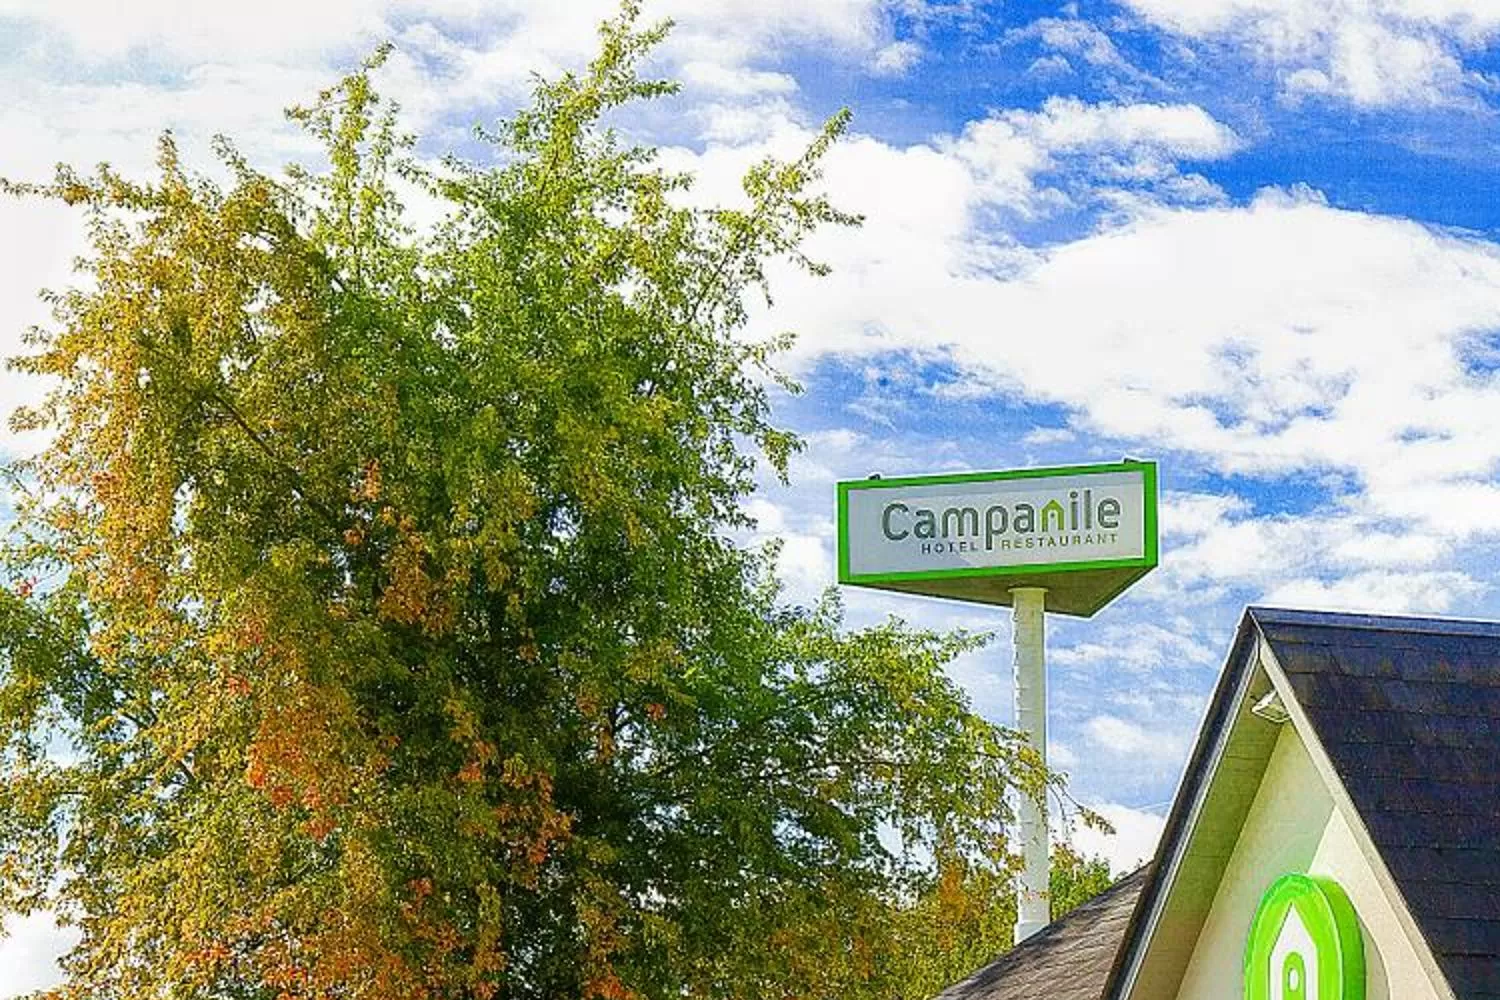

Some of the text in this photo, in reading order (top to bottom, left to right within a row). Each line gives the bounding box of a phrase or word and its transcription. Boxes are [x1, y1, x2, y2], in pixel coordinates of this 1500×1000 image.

[881, 489, 1121, 550] Campanile
[921, 532, 1118, 554] HOTEL RESTAURANT
